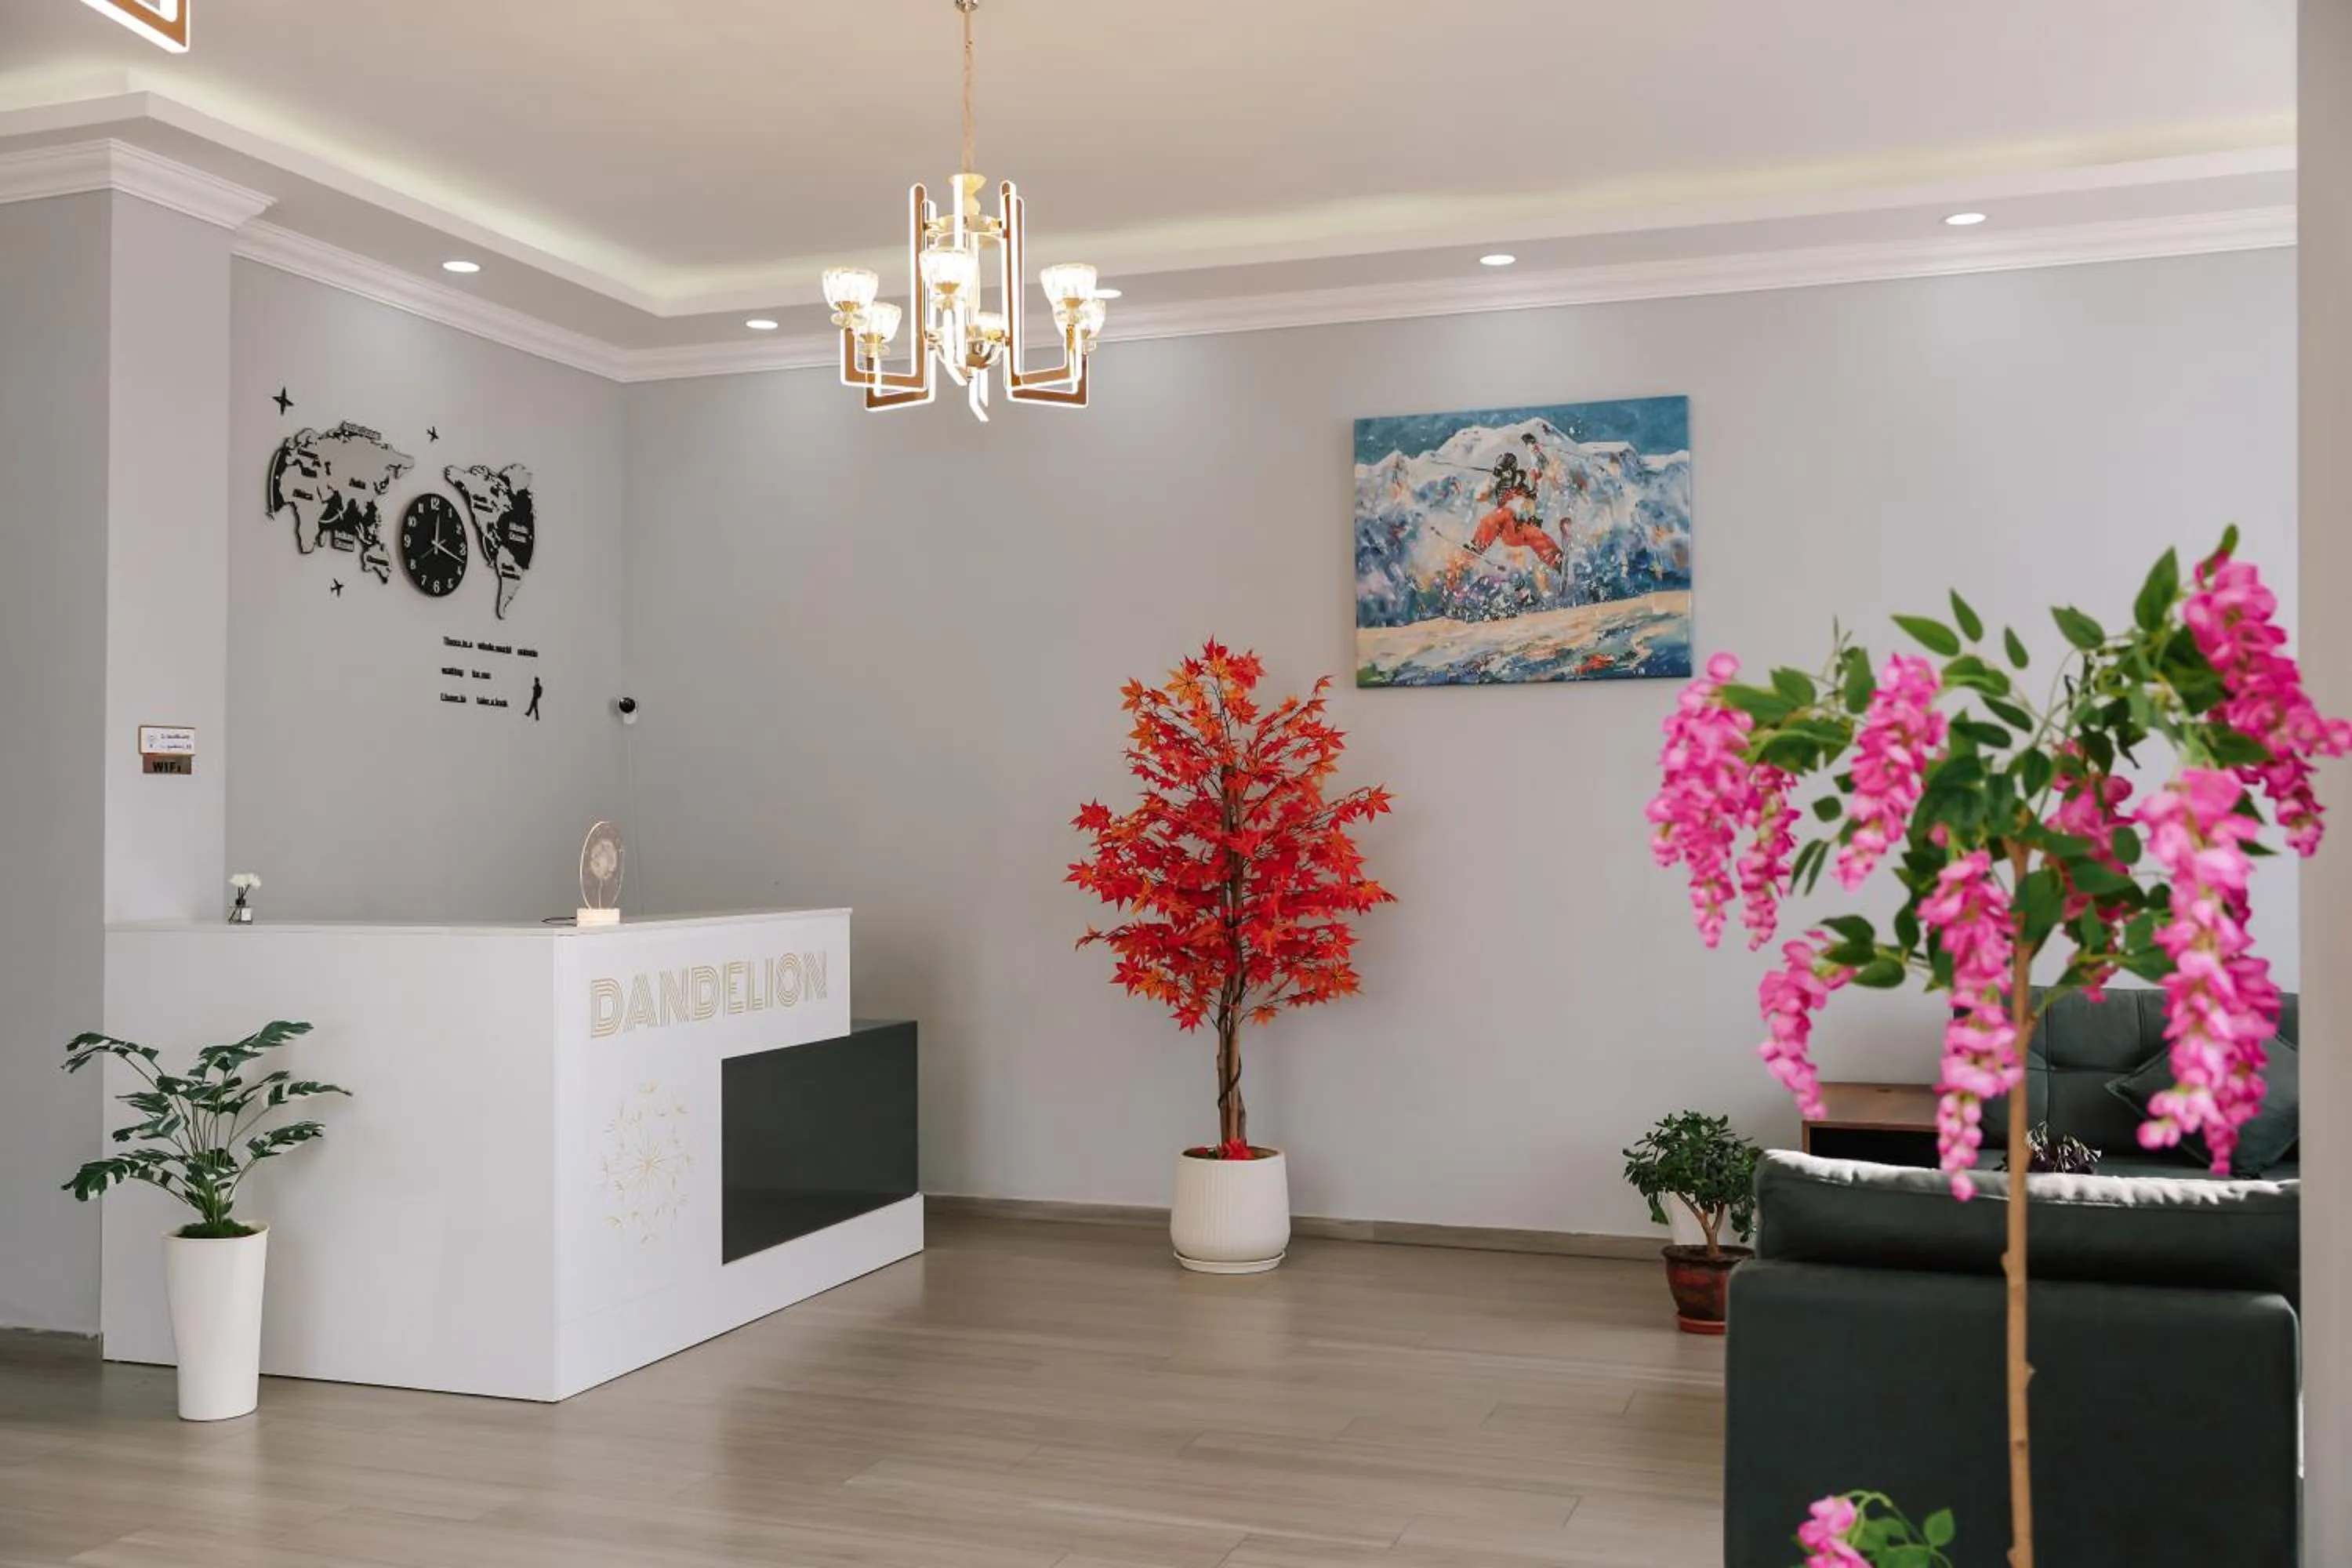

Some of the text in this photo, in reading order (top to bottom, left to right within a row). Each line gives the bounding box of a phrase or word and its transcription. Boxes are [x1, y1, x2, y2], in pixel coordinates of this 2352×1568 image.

[430, 497, 440, 510] 12
[404, 535, 412, 548] 9
[459, 543, 466, 556] 3
[410, 559, 417, 570] 8
[421, 575, 427, 586] 7
[433, 580, 440, 593] 6
[590, 949, 828, 1040] DANDELION
